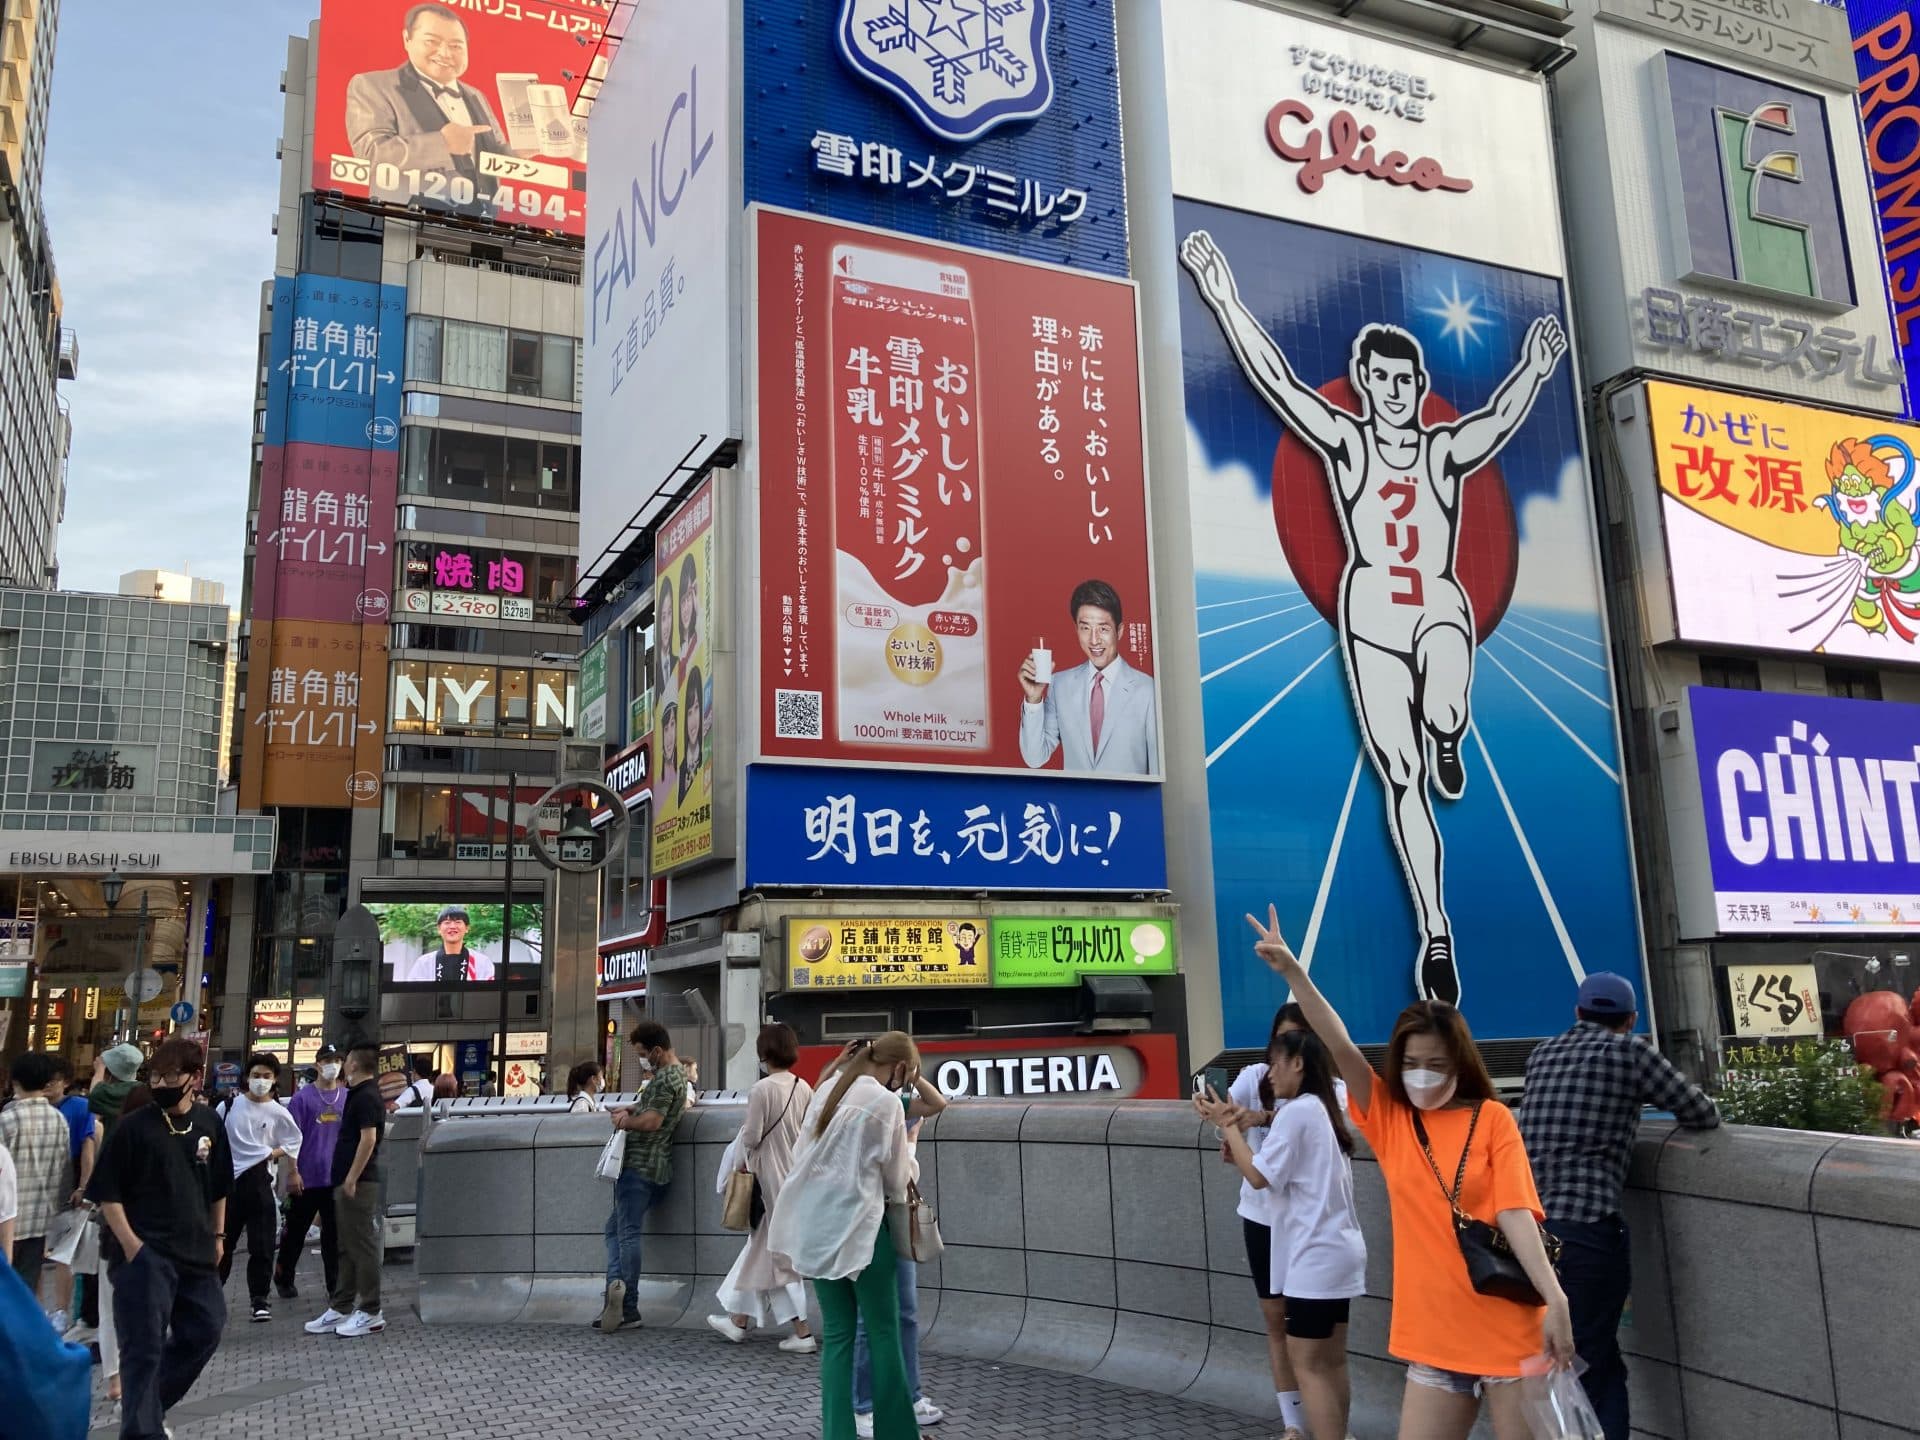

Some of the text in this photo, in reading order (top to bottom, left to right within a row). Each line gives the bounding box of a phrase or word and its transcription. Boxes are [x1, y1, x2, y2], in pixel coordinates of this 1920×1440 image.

[485, 157, 540, 178] ルアン
[1265, 99, 1474, 195] Glico
[375, 163, 586, 222] 0120-494-
[811, 129, 1087, 222] 雪印メグミルク
[592, 64, 713, 346] FANCL
[294, 316, 382, 359] 龍角散
[611, 256, 684, 396] 正直品質。
[1061, 326, 1073, 371] わけ
[845, 346, 884, 427] 牛乳
[1031, 315, 1064, 481] 理由がある。
[933, 356, 972, 506] おいしい
[1078, 324, 1113, 545] 赤には、おいしい
[1680, 403, 1789, 450] かぜに
[886, 335, 929, 581] 雪印メグミルク
[1671, 443, 1808, 514] 改源
[873, 467, 886, 497] 牛乳
[282, 487, 372, 528] 龍角散
[1377, 475, 1425, 607] グリコ
[408, 562, 428, 570] OPEN
[436, 551, 524, 593] 焼肉
[783, 595, 793, 645] 動画公開中
[890, 637, 937, 653] おいしさ
[894, 653, 936, 671] W技術
[271, 667, 362, 707] 龍角散
[395, 675, 490, 723] NY
[853, 725, 899, 739] 1000ml
[883, 709, 947, 725] Whole Milk
[52, 763, 136, 790] 戎橋筋
[72, 749, 120, 765] なんば
[10, 852, 63, 866] EBISU
[1727, 904, 1772, 922] 天気予報
[841, 928, 943, 945] 店舗情報館
[1052, 925, 1124, 963] ピタットハウス
[604, 949, 648, 982] LOTTERIA
[815, 975, 857, 985] 株式会社
[863, 974, 925, 984] 関西インベスト
[1748, 974, 1804, 1026] くくる
